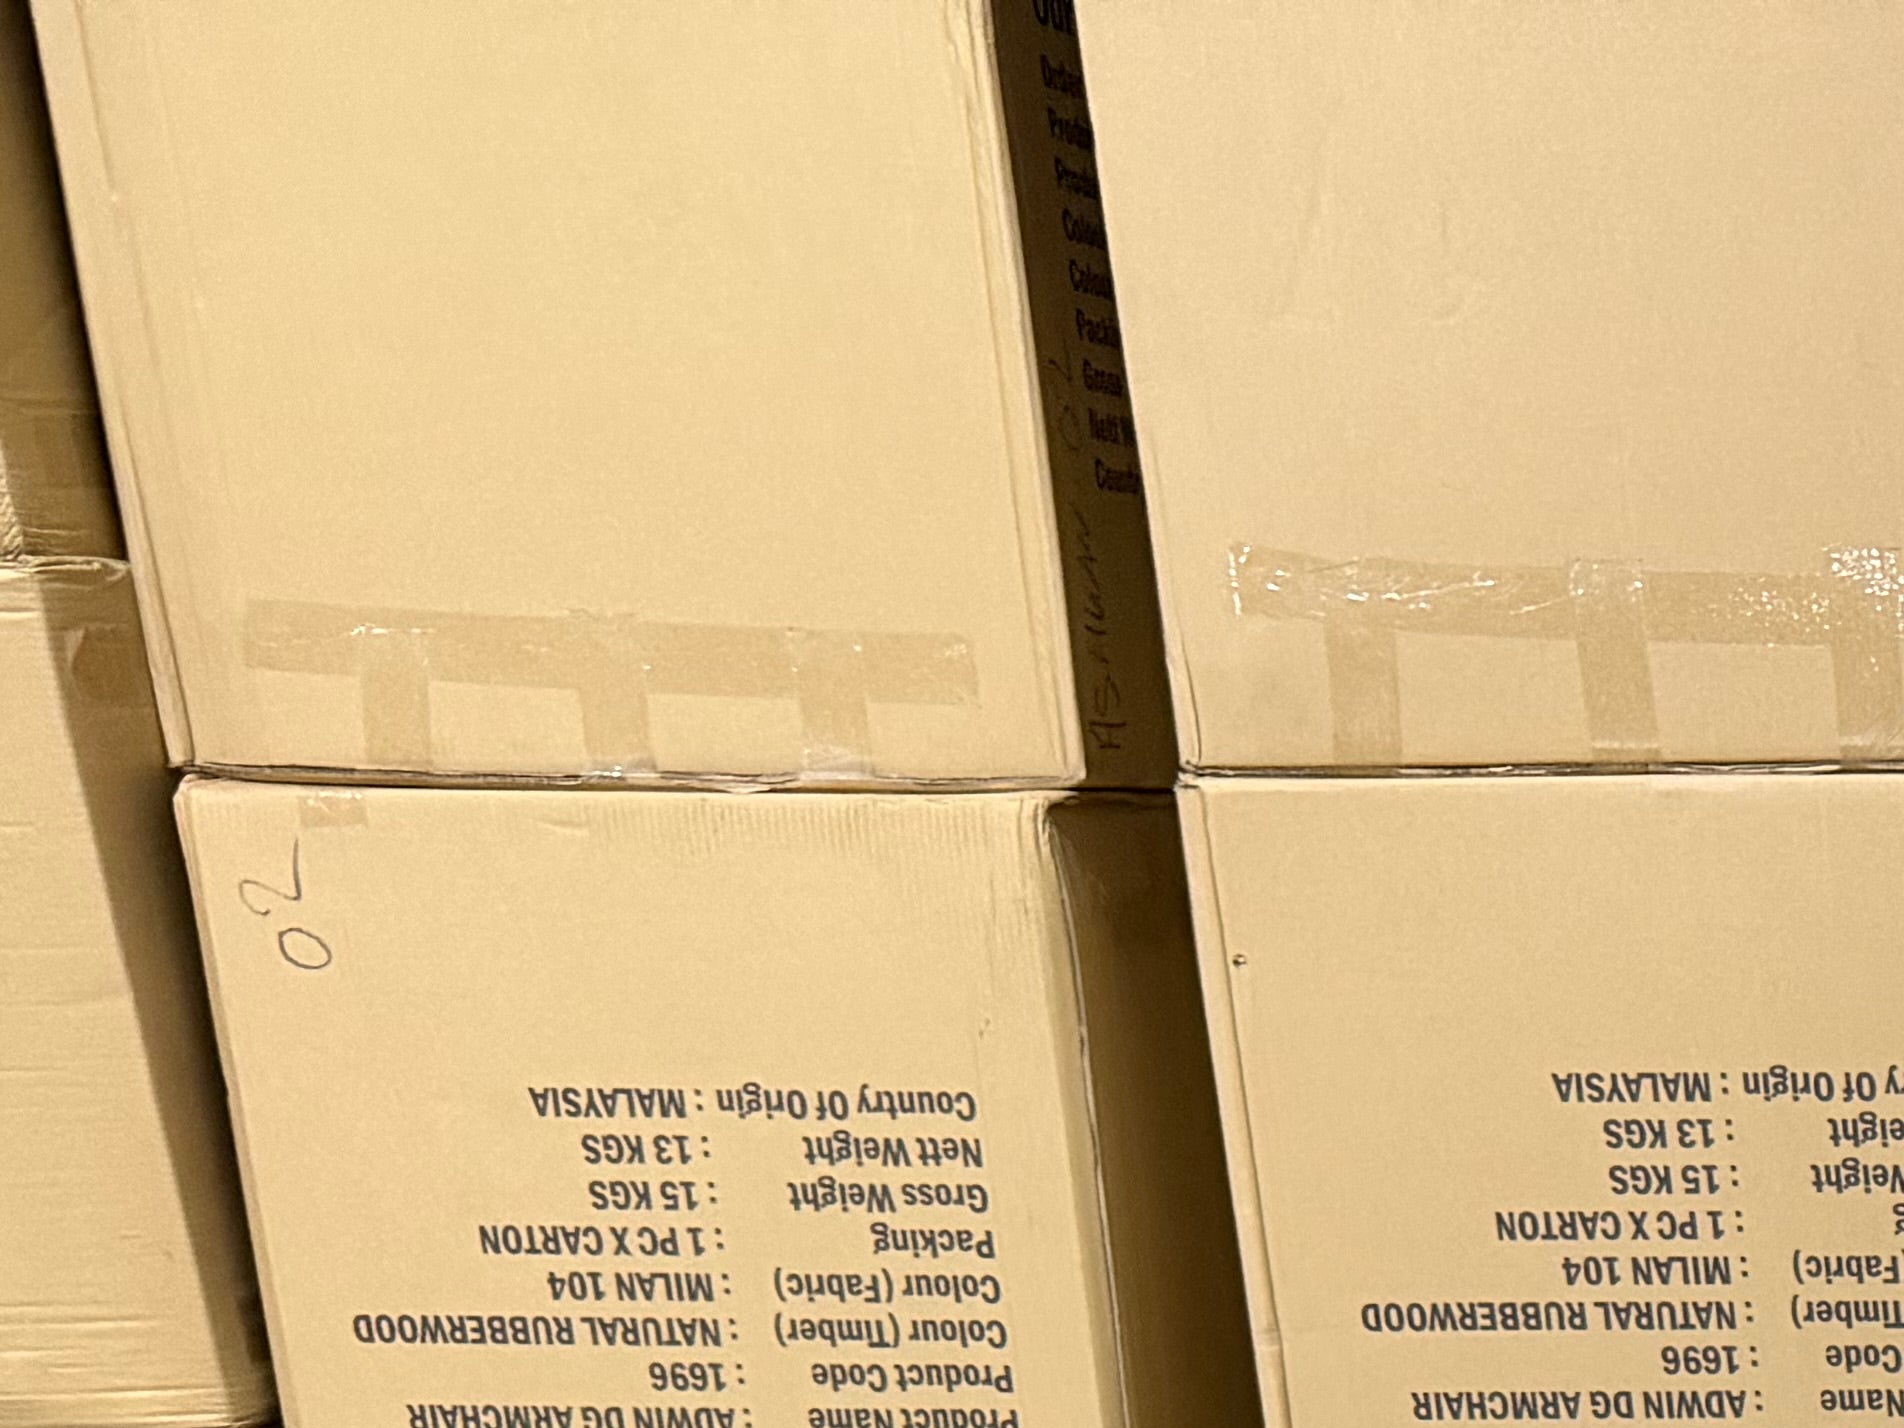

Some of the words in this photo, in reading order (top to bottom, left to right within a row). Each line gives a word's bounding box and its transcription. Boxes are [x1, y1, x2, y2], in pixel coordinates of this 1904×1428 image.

[479, 1225, 603, 1255] CARTON
[609, 1227, 632, 1255] X
[637, 1227, 679, 1256] PC
[687, 1227, 705, 1256] 1
[870, 1222, 995, 1258] Packing
[353, 1315, 575, 1344] RUBBERWOOD
[580, 1317, 721, 1347] NATURAL
[775, 1312, 900, 1348] (Timber)
[909, 1320, 1007, 1348] Colour
